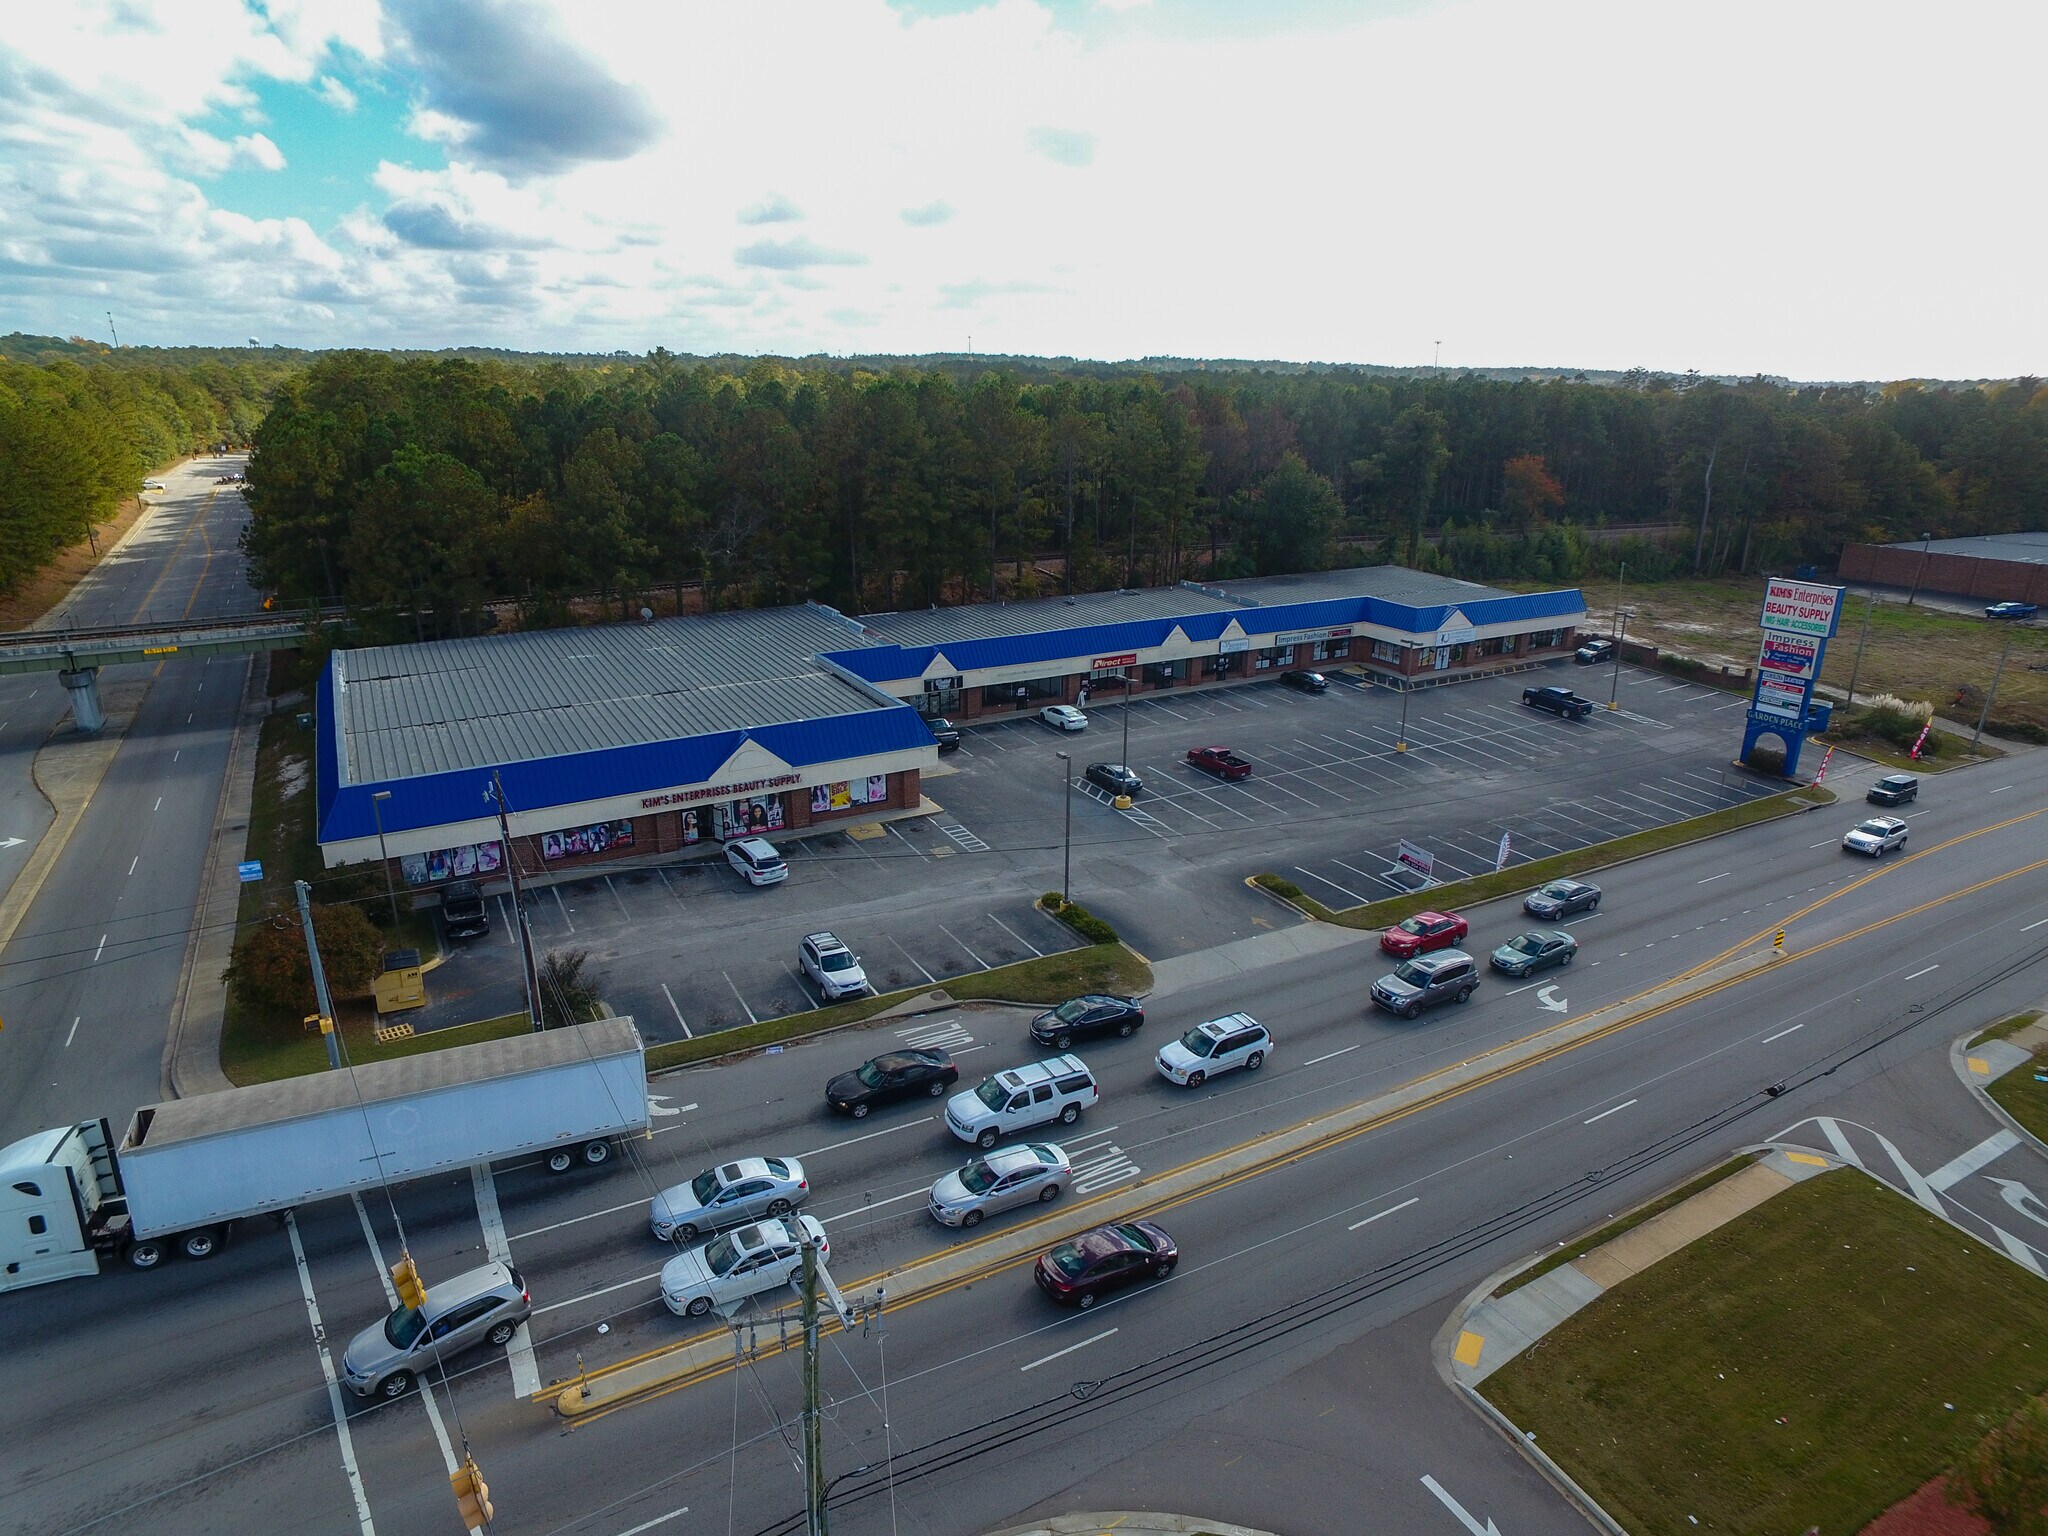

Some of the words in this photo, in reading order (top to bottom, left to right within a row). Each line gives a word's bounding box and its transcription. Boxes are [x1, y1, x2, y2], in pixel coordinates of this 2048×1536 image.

[1793, 588, 1834, 607] Enterprises
[1765, 602, 1799, 616] BEAUTY
[1798, 607, 1830, 622] SUPPLY
[1278, 635, 1303, 643] Impress
[1303, 632, 1327, 641] Fashion
[1768, 632, 1814, 648] Impress
[1772, 642, 1812, 657] Fashion
[1747, 710, 1779, 724] GARDEN
[641, 795, 670, 809] KIM'S
[672, 785, 731, 803] ENTERPRISES
[733, 778, 767, 796] BEAUTY
[768, 773, 802, 788] SUPPLY
